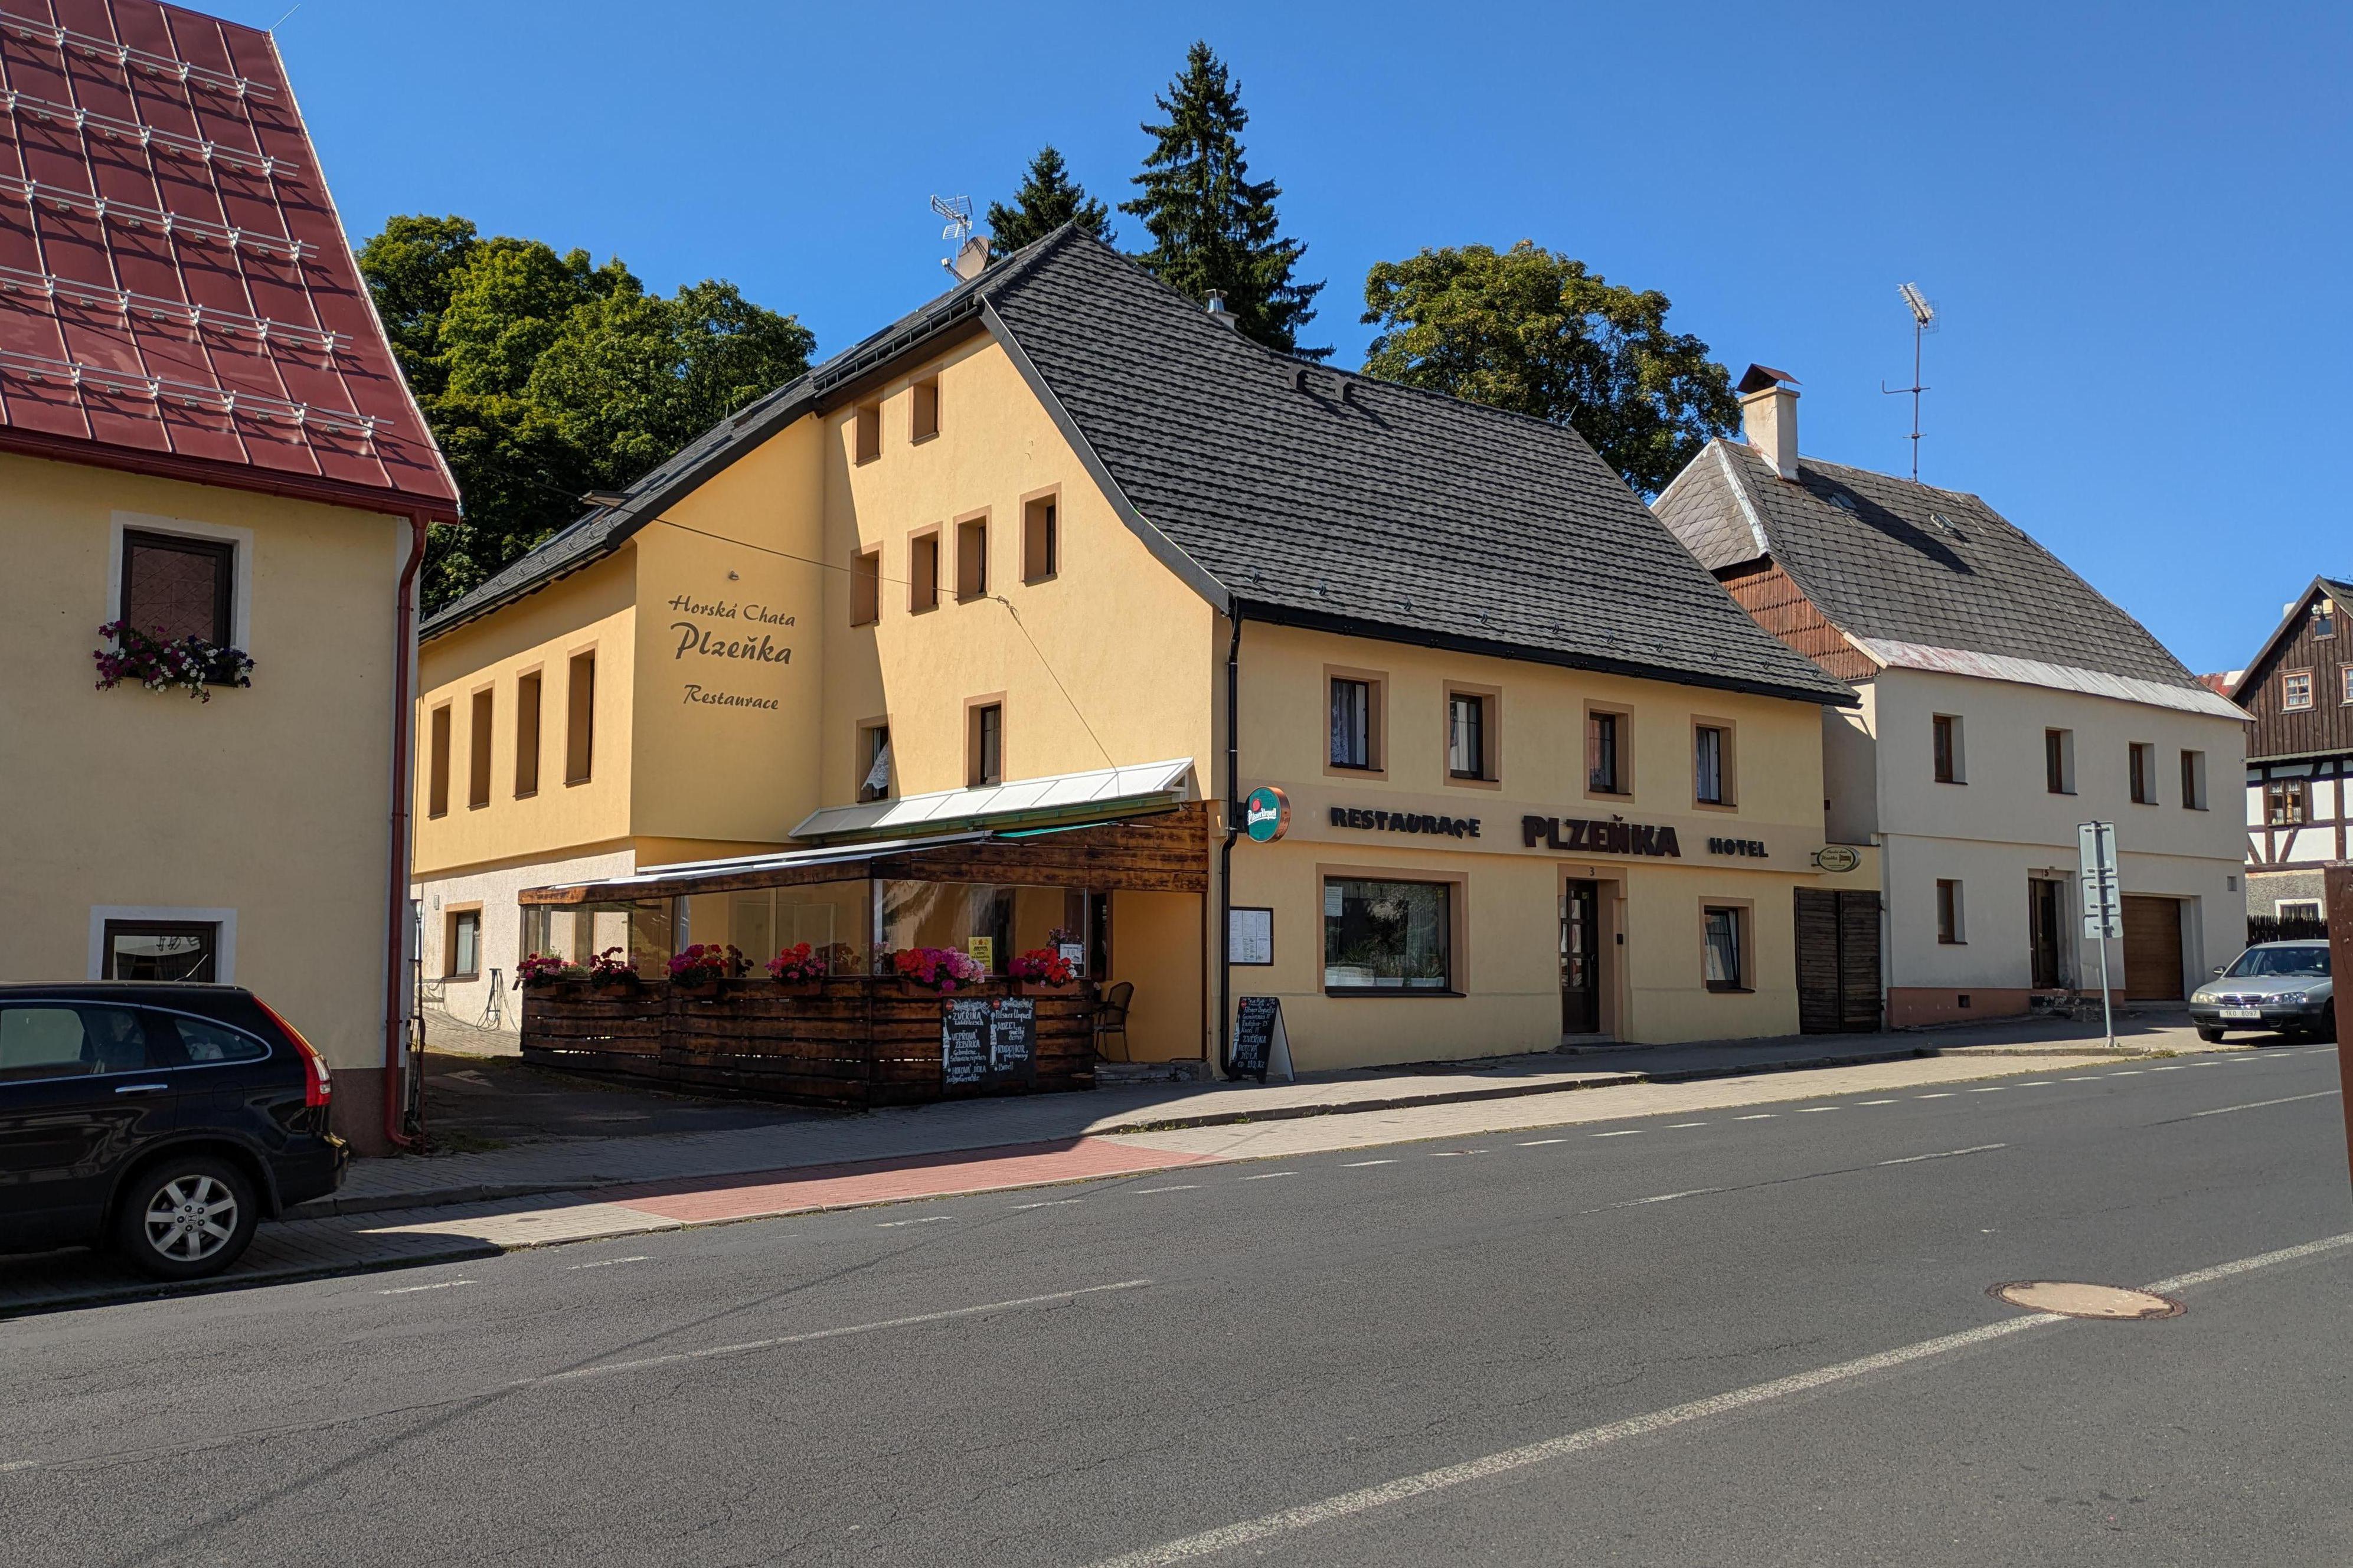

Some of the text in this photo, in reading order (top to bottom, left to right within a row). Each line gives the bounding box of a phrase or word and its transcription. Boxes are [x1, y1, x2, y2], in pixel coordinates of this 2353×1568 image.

[668, 595, 795, 627] Horská Chata
[670, 621, 792, 664] Plzeňka
[683, 685, 779, 709] Restaurace
[1247, 808, 1276, 826] Pilsner Urquell
[1331, 807, 1481, 839] RESTAURACE
[1523, 814, 1681, 857] PLZEŇKA
[1710, 837, 1769, 857] HOTEL
[1589, 867, 1595, 876] 3
